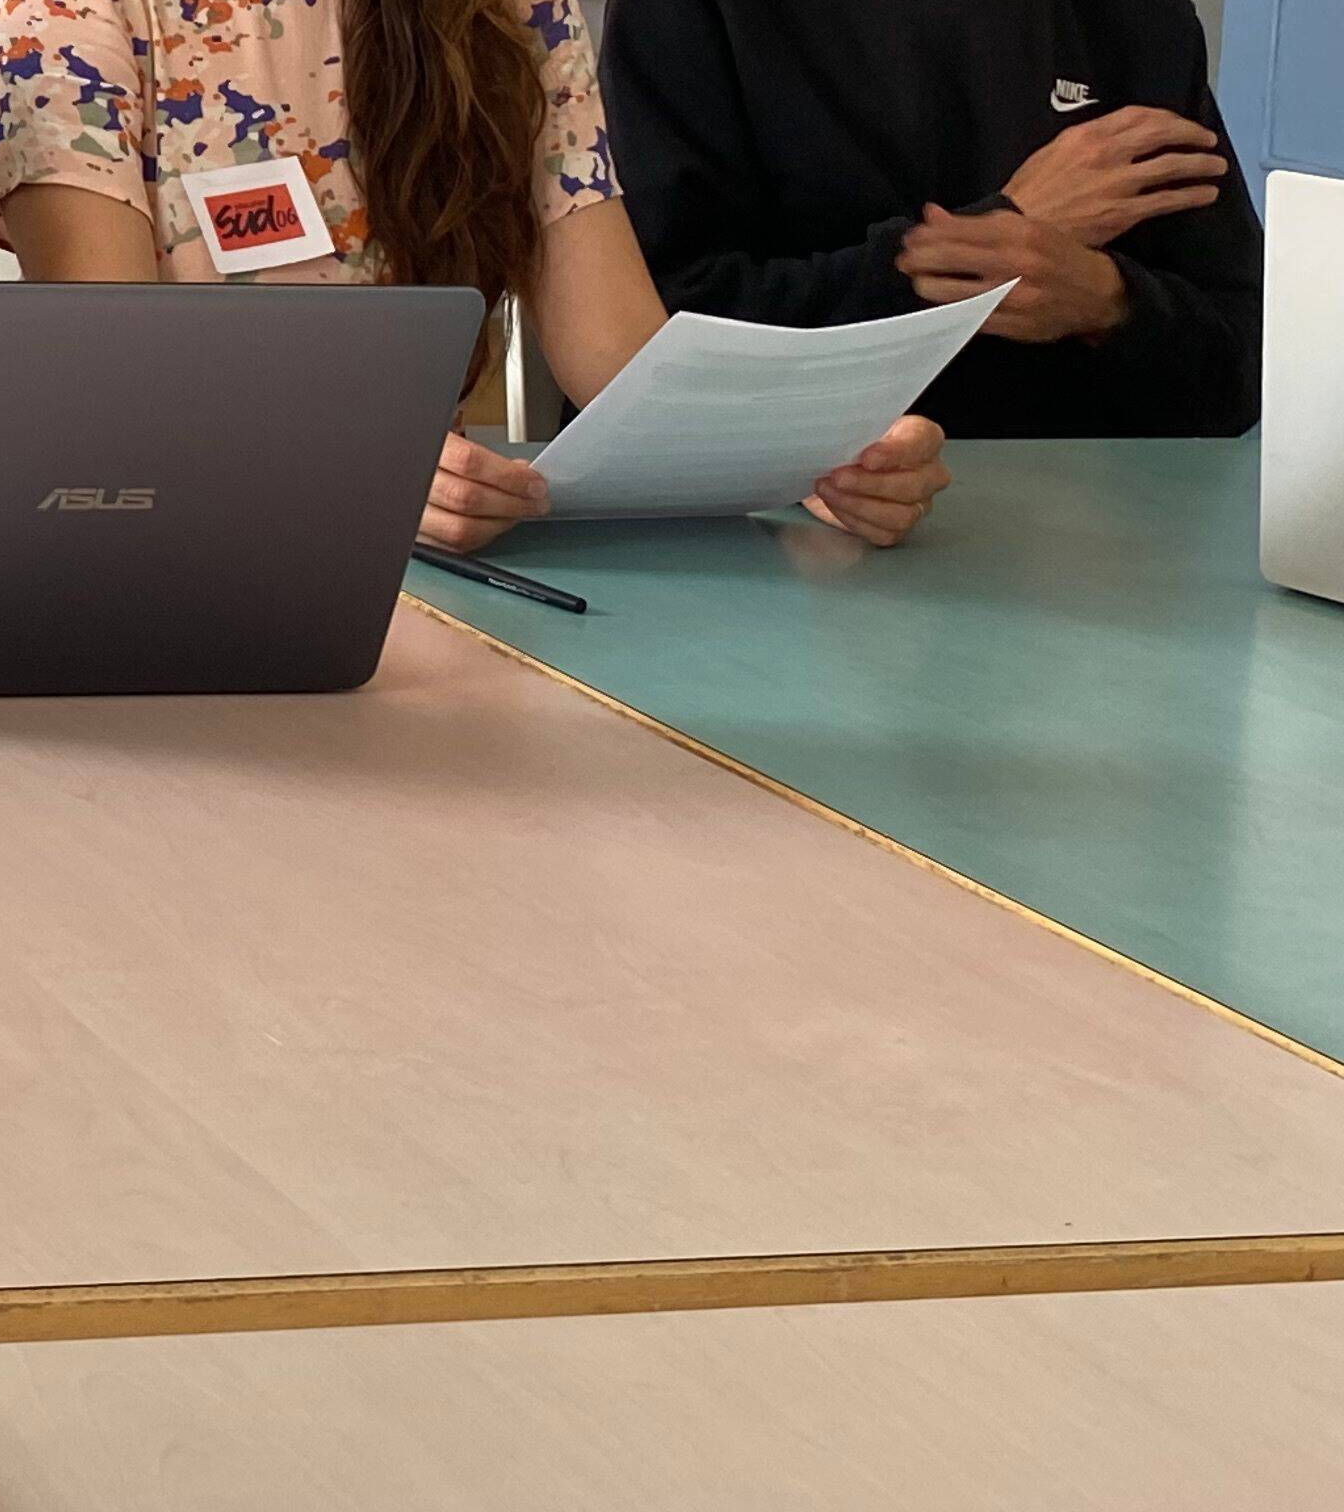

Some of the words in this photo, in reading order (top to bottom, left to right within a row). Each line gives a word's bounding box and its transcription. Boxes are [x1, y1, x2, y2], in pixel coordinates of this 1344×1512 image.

[1055, 78, 1090, 102] NIKE
[215, 195, 279, 240] Sud
[36, 487, 157, 510] ASUS
